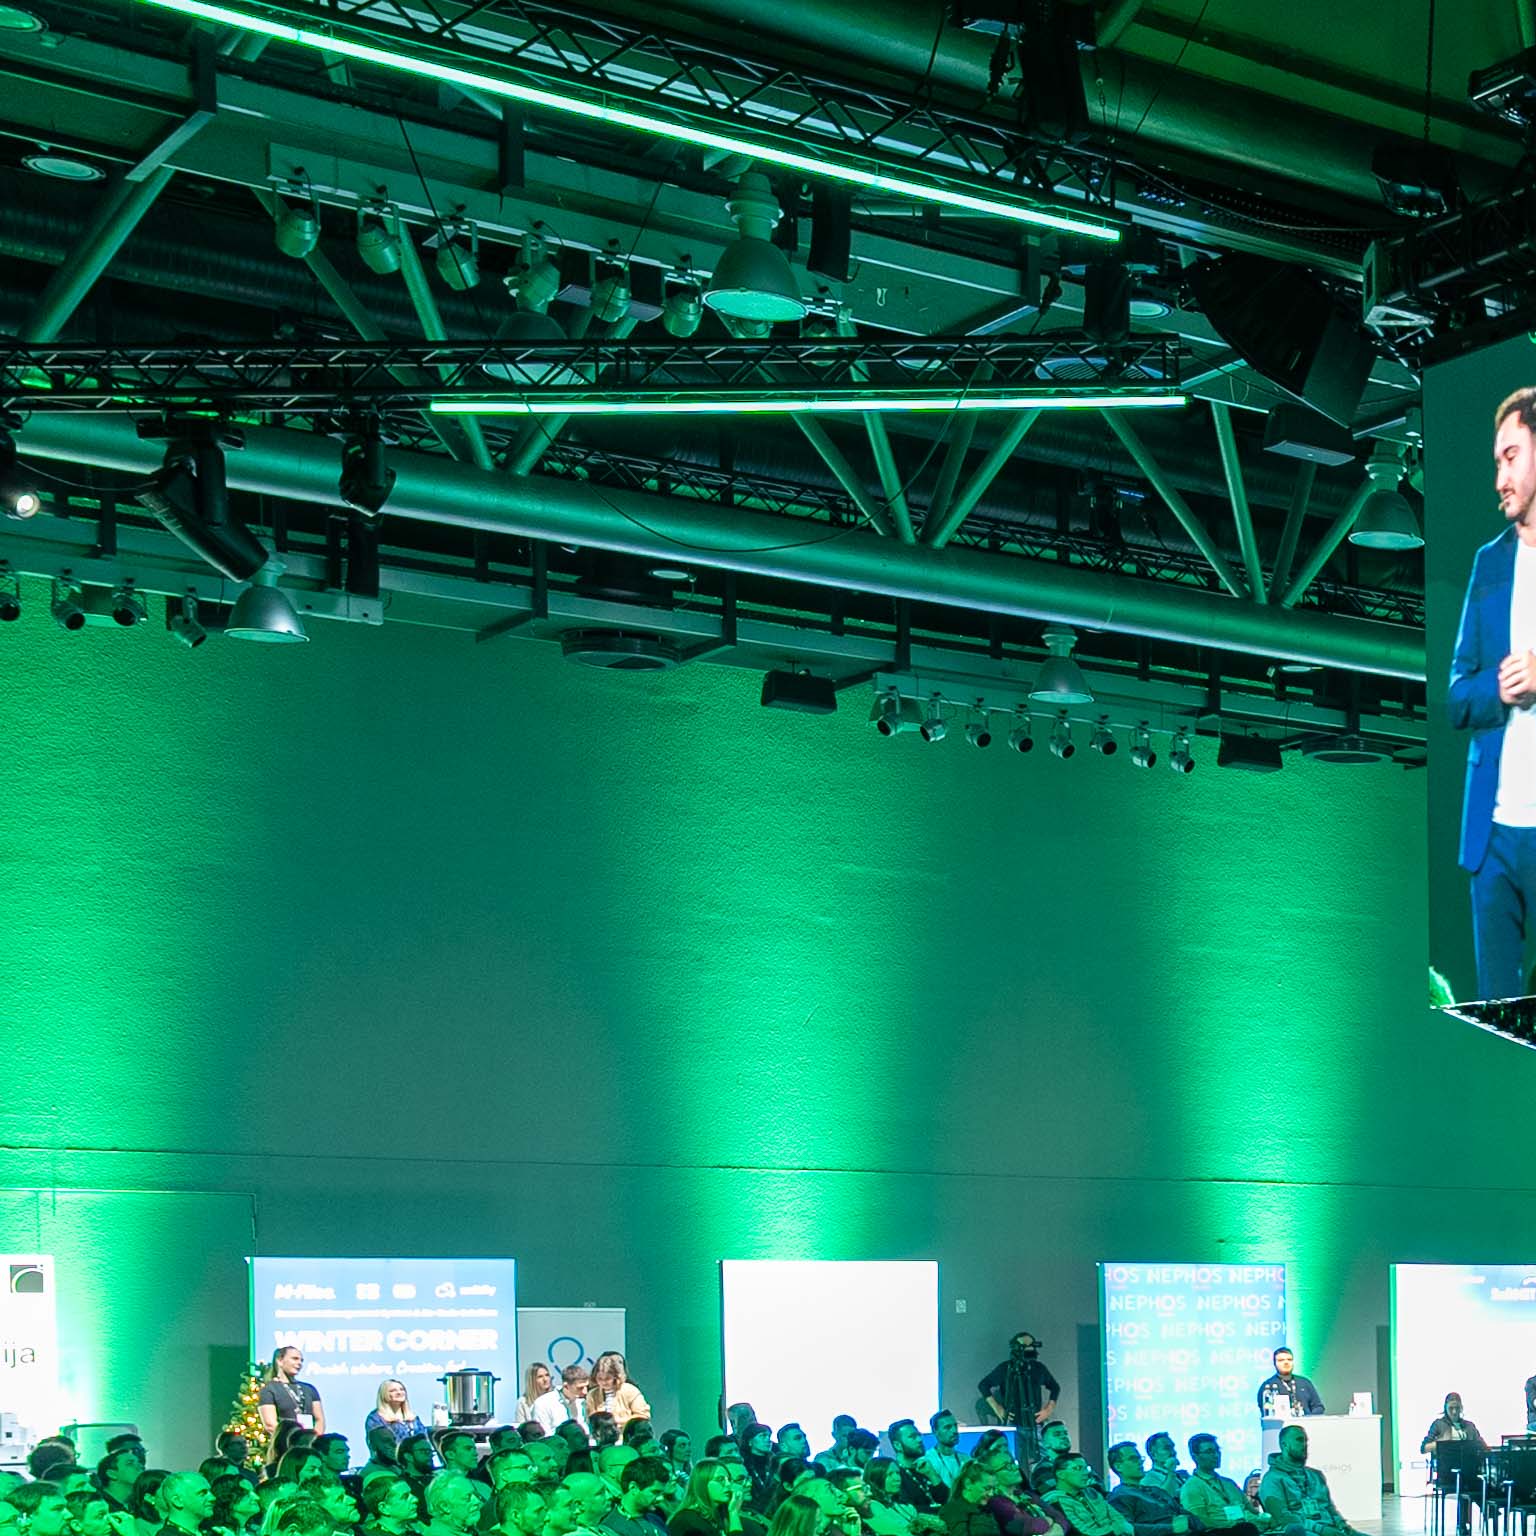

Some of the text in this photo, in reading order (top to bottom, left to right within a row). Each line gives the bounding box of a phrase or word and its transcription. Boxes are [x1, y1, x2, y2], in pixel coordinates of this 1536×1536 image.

[1146, 1267, 1222, 1283] NEPHOS
[1110, 1295, 1186, 1311] NEPHOS
[1196, 1295, 1270, 1311] NEPHOS
[387, 1328, 499, 1351] CORNER
